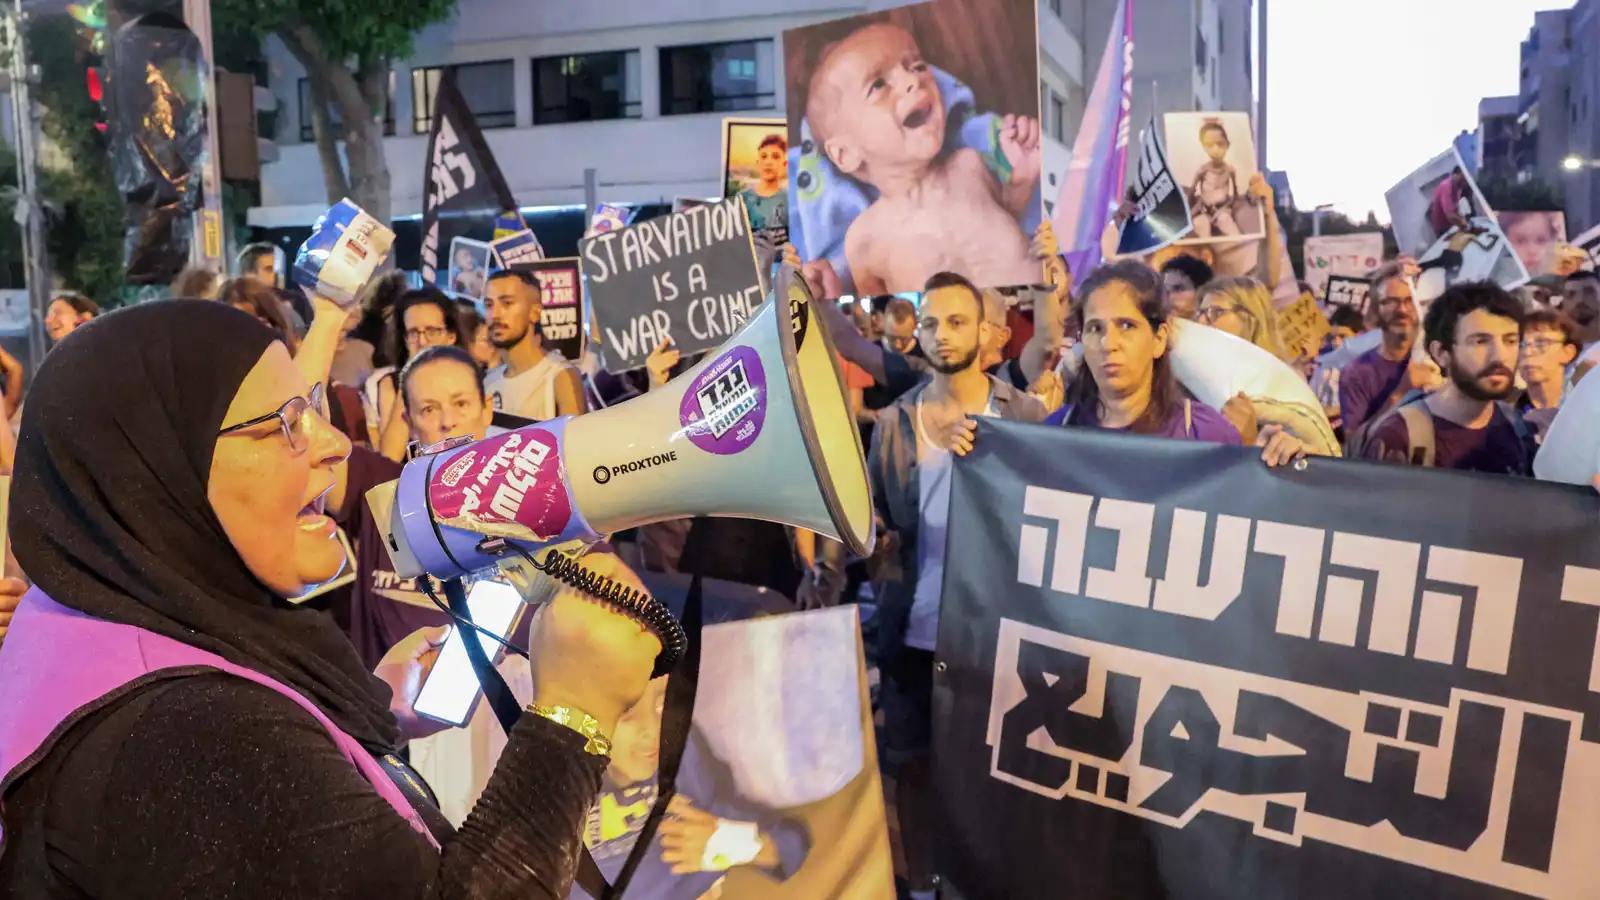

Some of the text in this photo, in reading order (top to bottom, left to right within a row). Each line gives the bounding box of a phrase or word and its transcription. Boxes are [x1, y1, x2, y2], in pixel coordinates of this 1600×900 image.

[585, 194, 743, 282] STARVATION
[652, 263, 707, 302] IS A
[605, 310, 675, 361] WAR
[687, 285, 760, 340] CRIME
[700, 364, 744, 406] נגד
[714, 396, 754, 434] המוות
[489, 439, 551, 521] שלום
[612, 451, 677, 477] PROXTONE
[1017, 485, 1524, 675] ההרעבה
[996, 638, 1572, 873] التجويع
